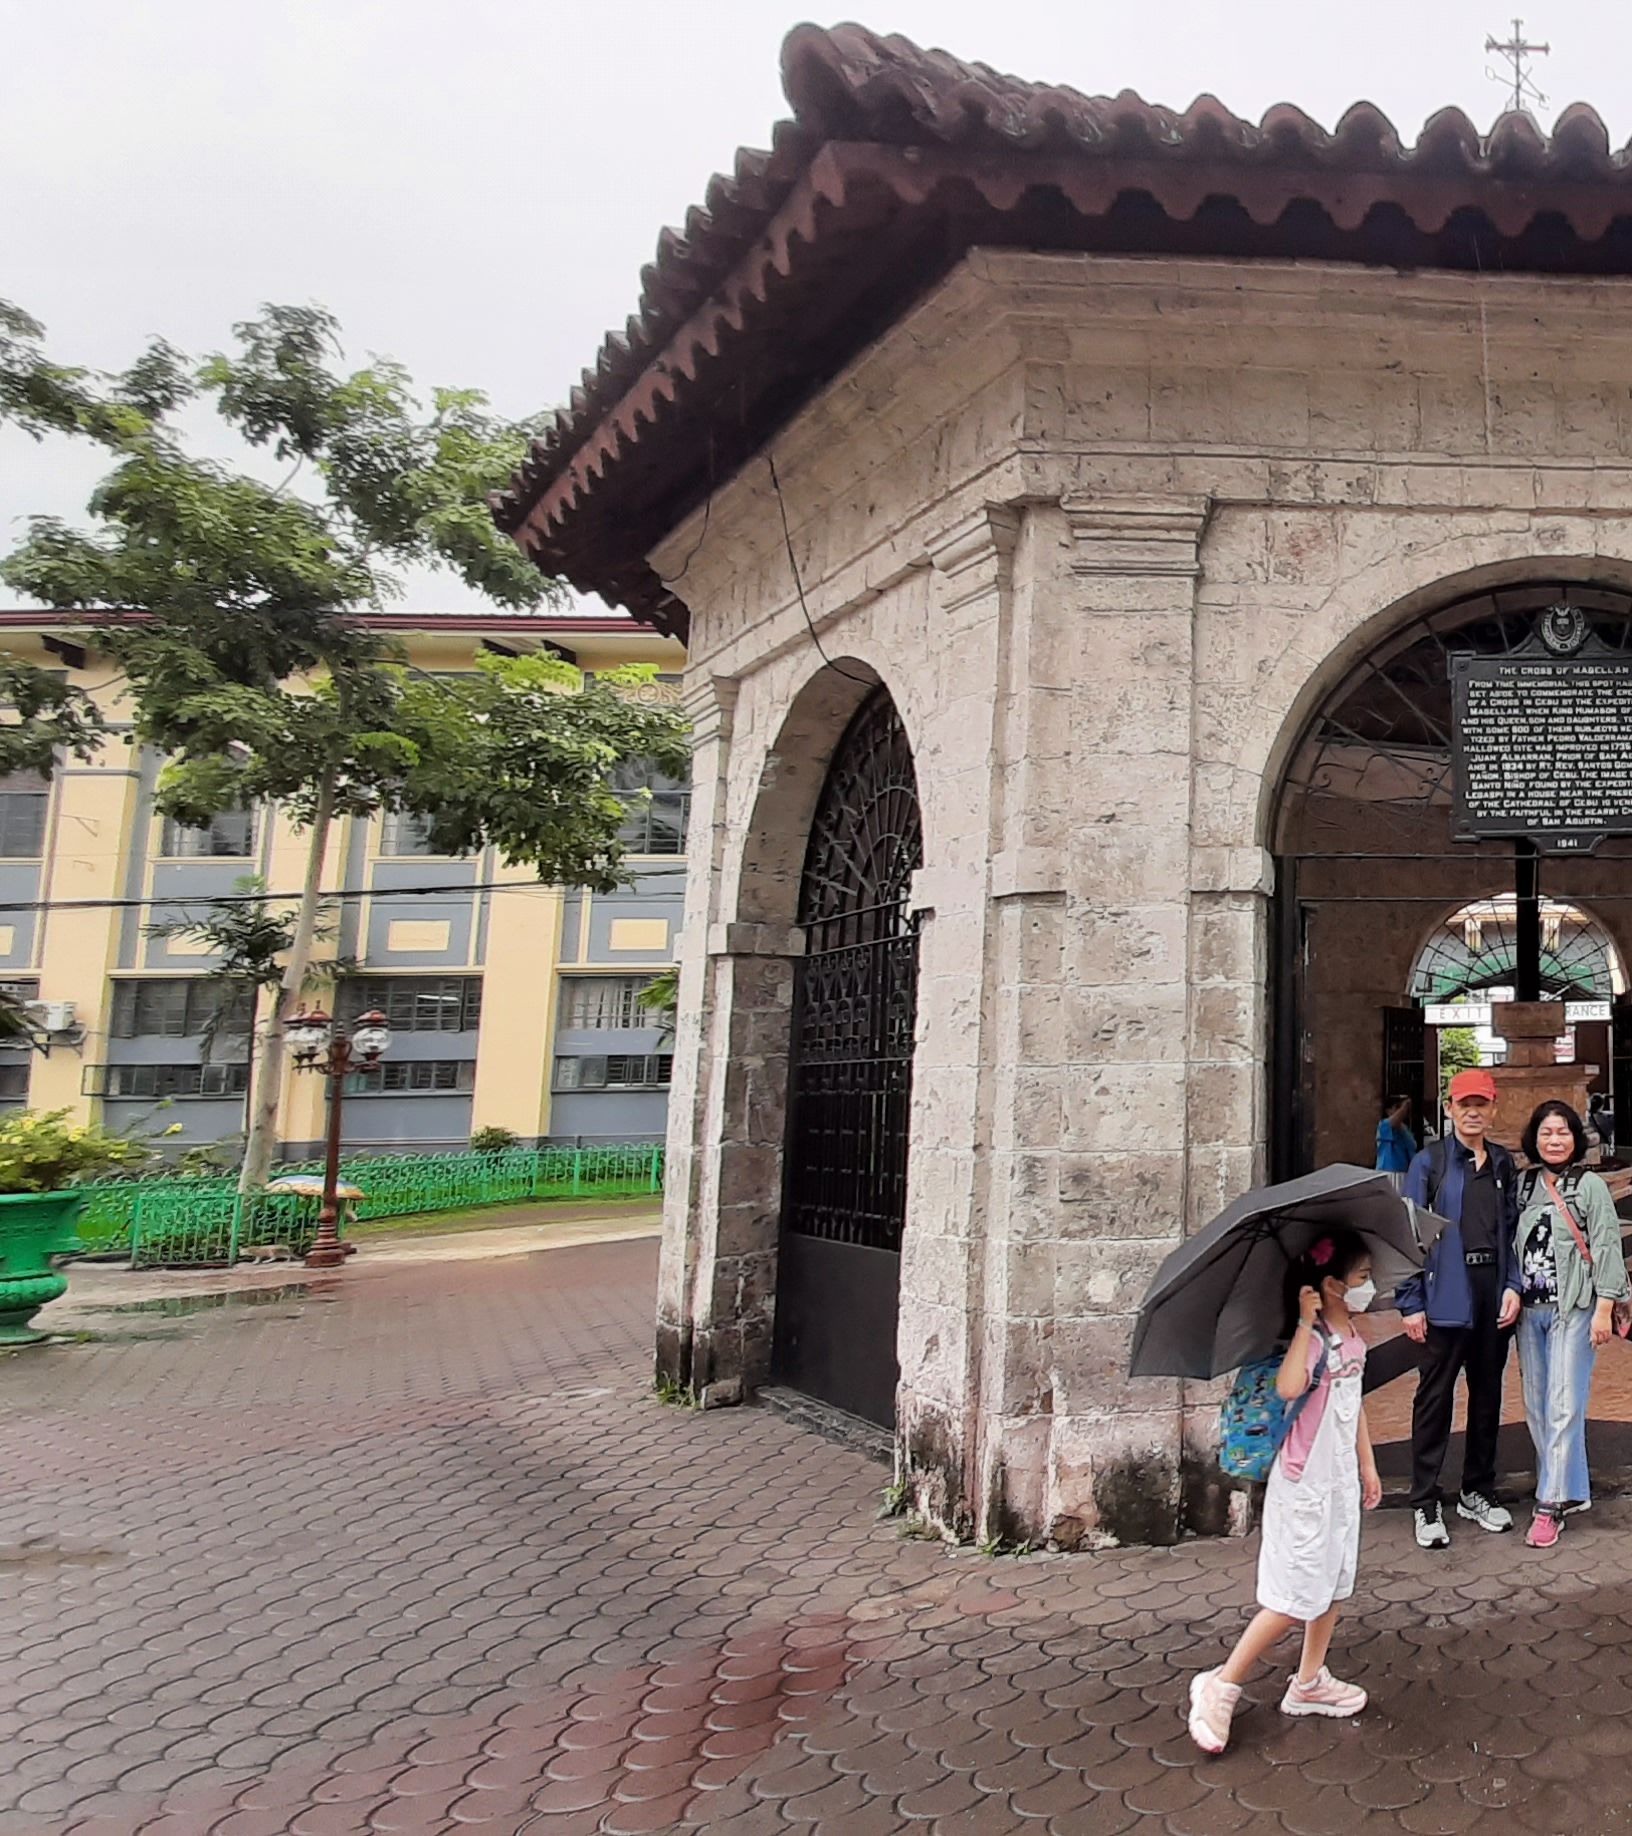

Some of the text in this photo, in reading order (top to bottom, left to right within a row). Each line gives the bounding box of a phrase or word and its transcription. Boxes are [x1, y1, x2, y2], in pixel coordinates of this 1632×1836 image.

[1499, 667, 1516, 675] THE
[1521, 667, 1552, 675] CROSS
[1556, 667, 1569, 675] OF
[1469, 680, 1492, 688] FROM
[1517, 680, 1568, 688] IMMEMORIAL
[1470, 690, 1486, 698] SET
[1539, 762, 1552, 770] RT.
[1504, 772, 1536, 780] BISHOP
[1503, 800, 1555, 808] CATHEDRAL
[1557, 839, 1577, 847] 1941
[1439, 1008, 1482, 1019] EXIT
[1565, 1005, 1605, 1017] RANCE
